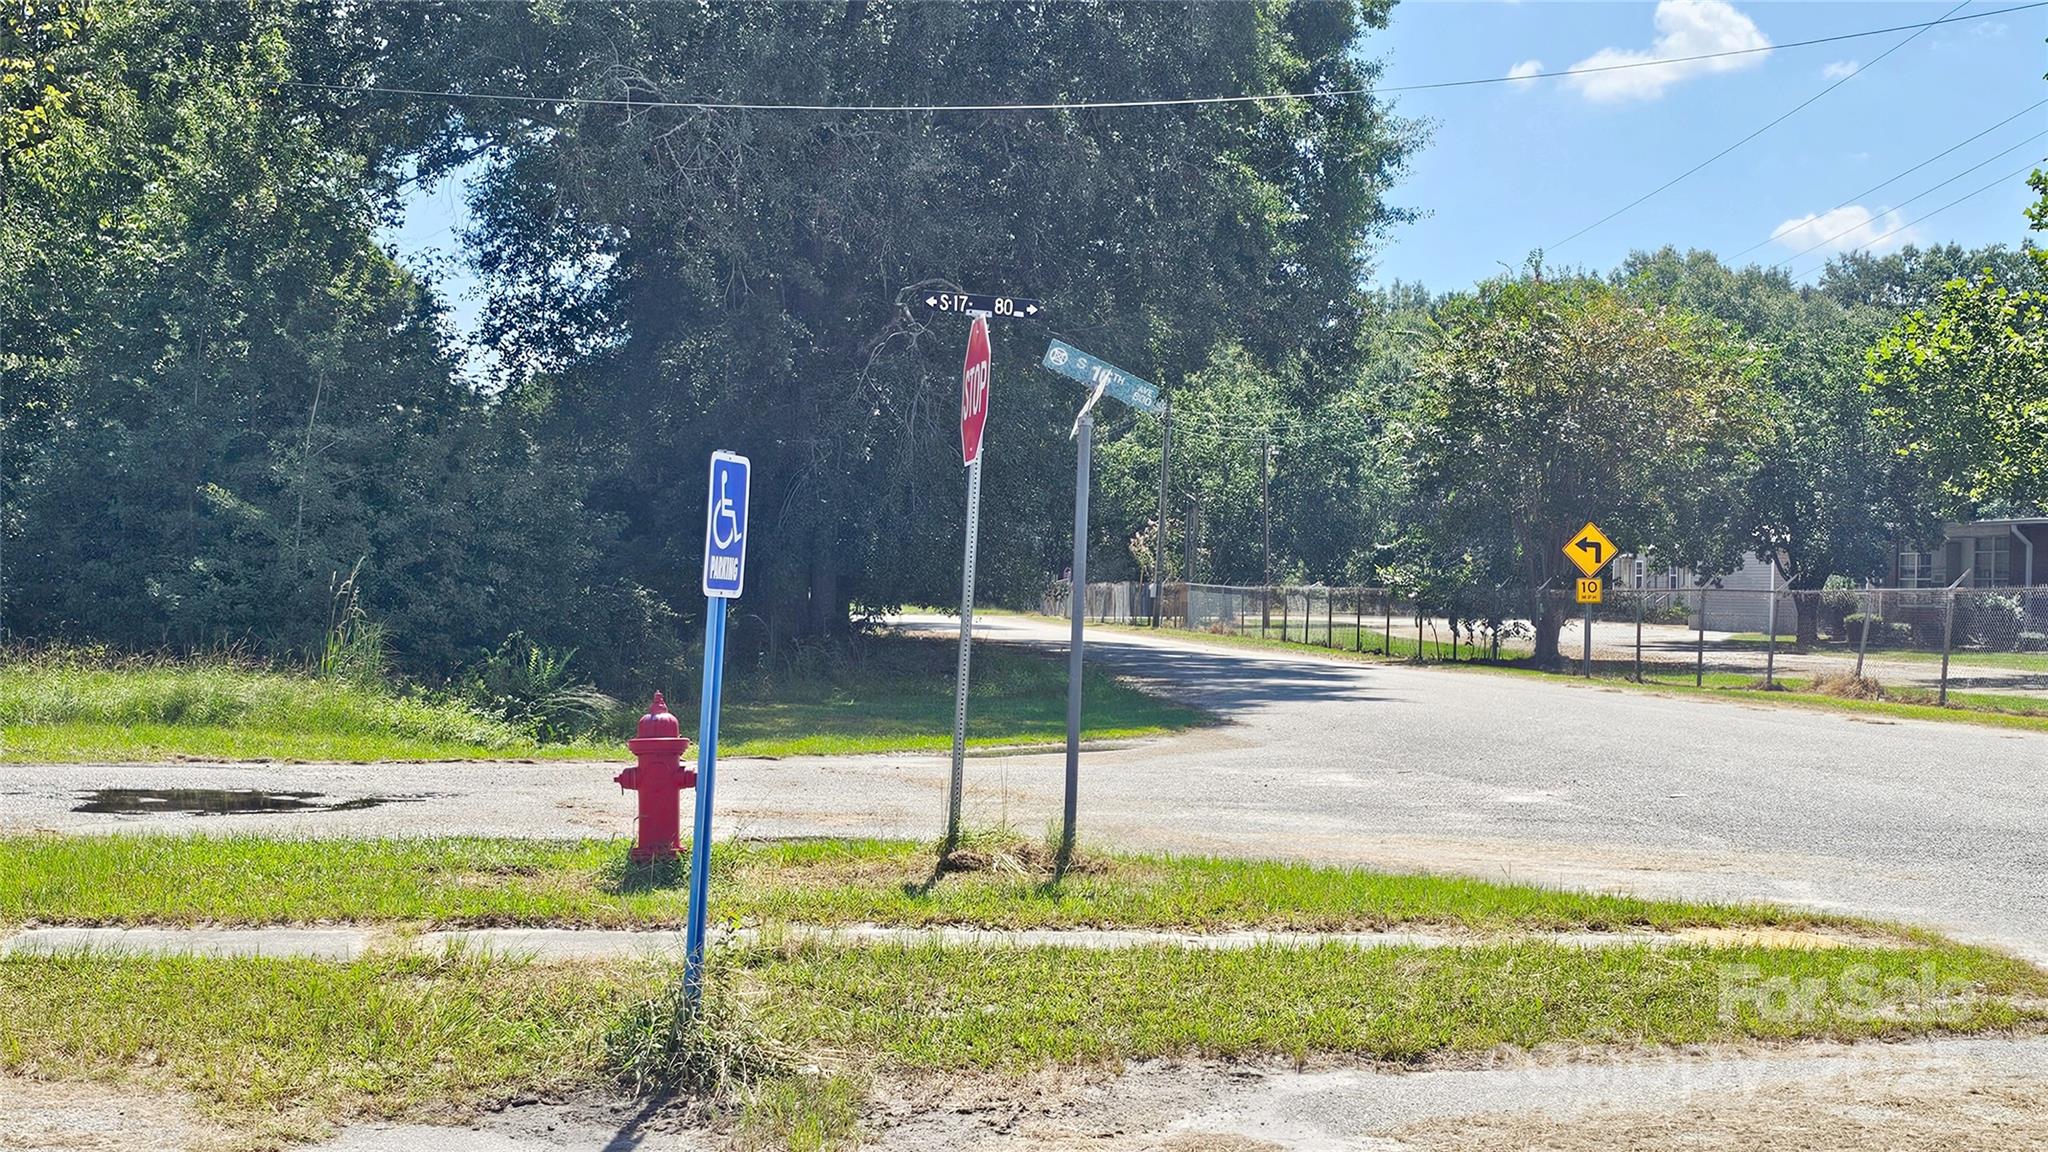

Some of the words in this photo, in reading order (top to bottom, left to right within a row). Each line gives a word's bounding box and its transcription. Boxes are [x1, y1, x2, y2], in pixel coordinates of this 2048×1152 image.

[994, 297, 1014, 316] 80
[1076, 357, 1088, 369] S
[963, 360, 988, 420] STOP
[710, 555, 739, 581] PARKING
[1581, 581, 1598, 593] 10
